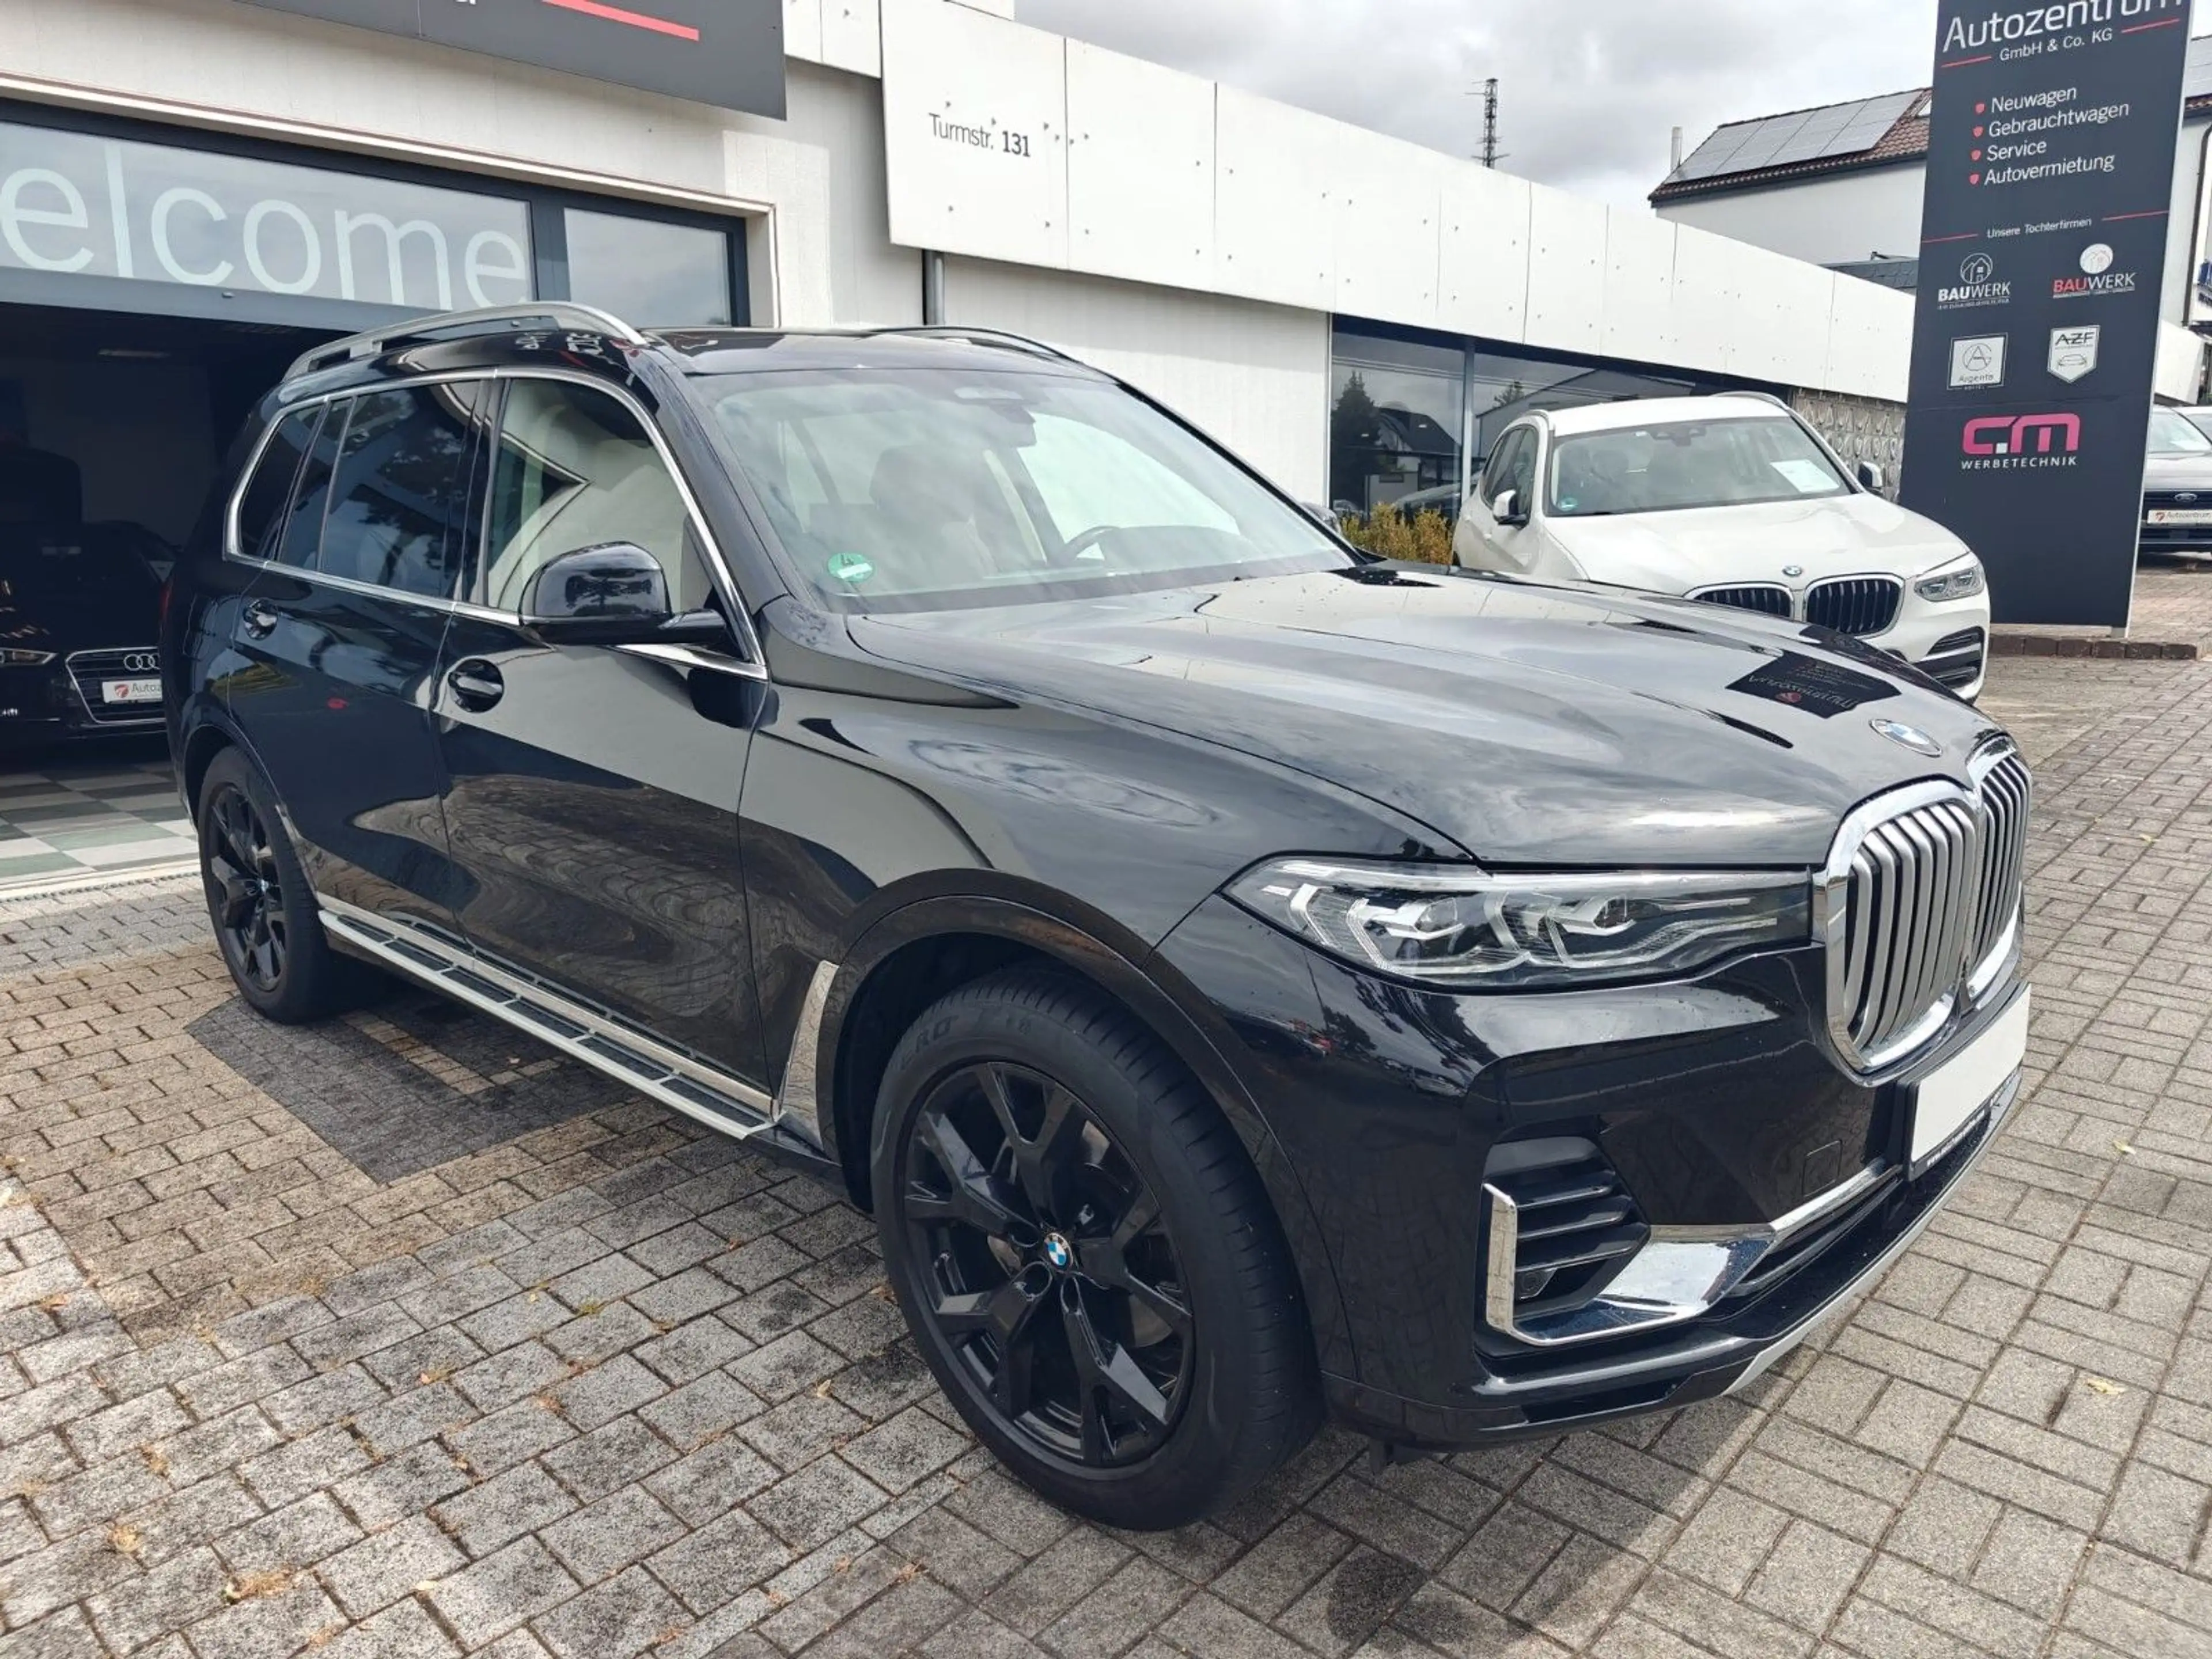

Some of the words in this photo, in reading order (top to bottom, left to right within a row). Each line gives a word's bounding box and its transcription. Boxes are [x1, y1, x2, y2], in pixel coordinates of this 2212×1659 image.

[1999, 40, 2043, 62] GmbH
[2047, 39, 2059, 52] &
[2063, 35, 2085, 48] Co.
[2092, 28, 2113, 44] KG
[1991, 86, 2077, 113] Neuwagen
[1988, 102, 2130, 138] Gebrauchtwagen
[928, 112, 994, 150] Turmstr.
[1002, 130, 1031, 157] 131
[1986, 139, 2047, 162] Service
[1984, 154, 2115, 185] Autovermietung
[1987, 227, 2021, 238] Unsere
[2024, 218, 2092, 235] Tochterfirmen
[1938, 281, 2012, 302] BAUWERK
[2053, 272, 2137, 294] BAUWERK
[2055, 331, 2096, 346] AZF
[1961, 455, 2077, 470] WERBETECHNIK
